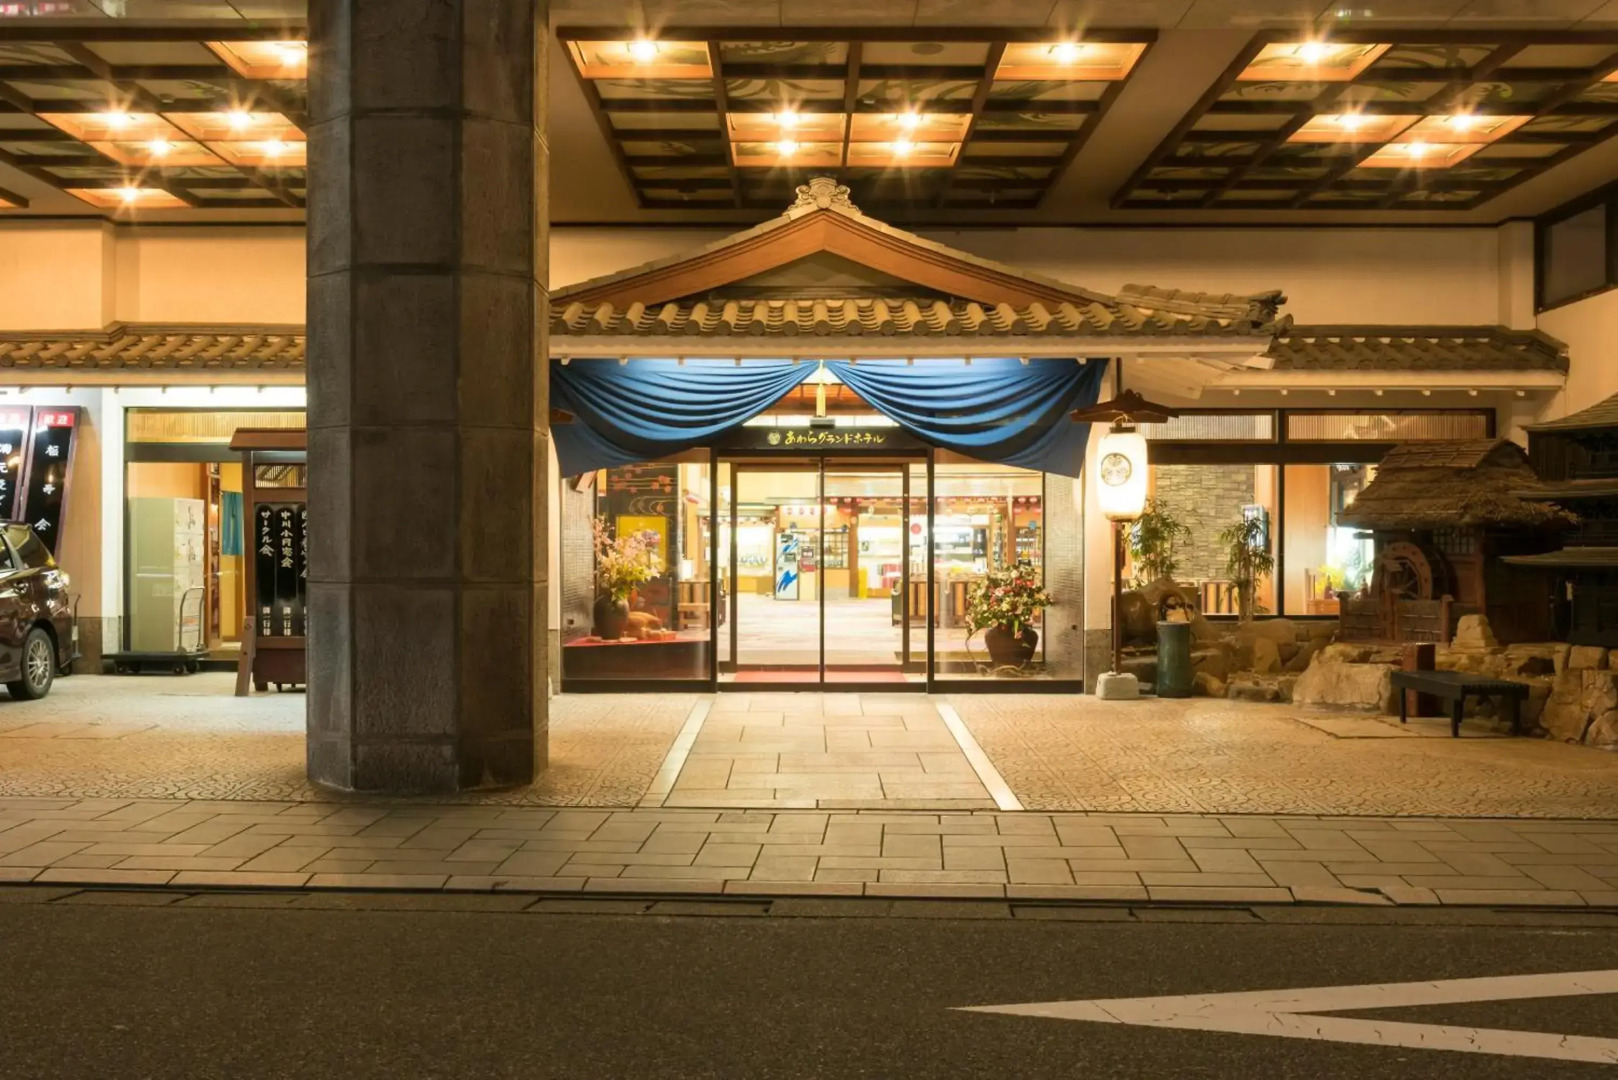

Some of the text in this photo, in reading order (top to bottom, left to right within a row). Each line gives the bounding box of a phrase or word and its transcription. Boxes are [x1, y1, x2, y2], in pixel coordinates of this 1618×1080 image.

[784, 430, 887, 446] あわらグランドホテル
[259, 510, 275, 557] サークル会
